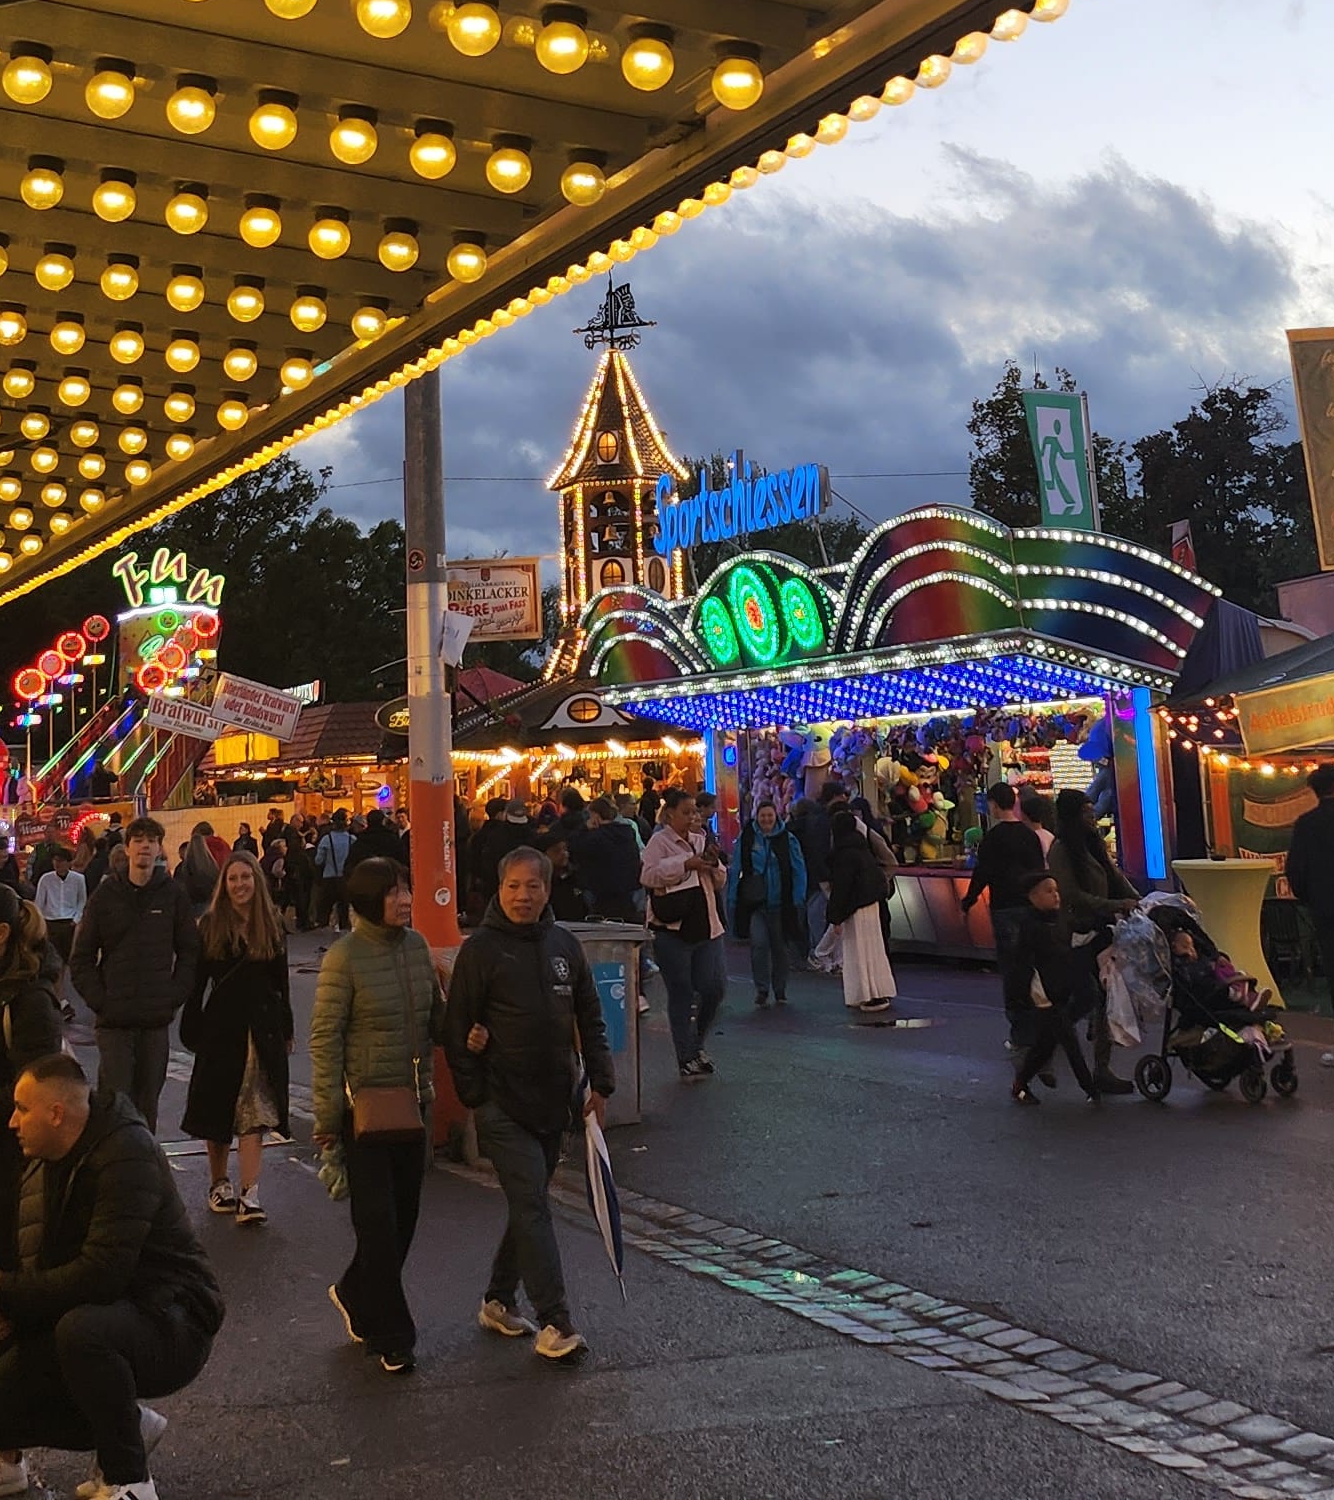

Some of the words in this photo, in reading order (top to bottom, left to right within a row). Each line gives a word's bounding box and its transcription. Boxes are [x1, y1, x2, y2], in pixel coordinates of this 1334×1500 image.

[654, 450, 820, 568] Sportschiessen
[112, 547, 226, 608] Fun
[151, 701, 218, 730] Bratwurst
[224, 698, 244, 714] oder
[243, 702, 285, 726] Rindswurst
[262, 691, 297, 715] Bratwurst
